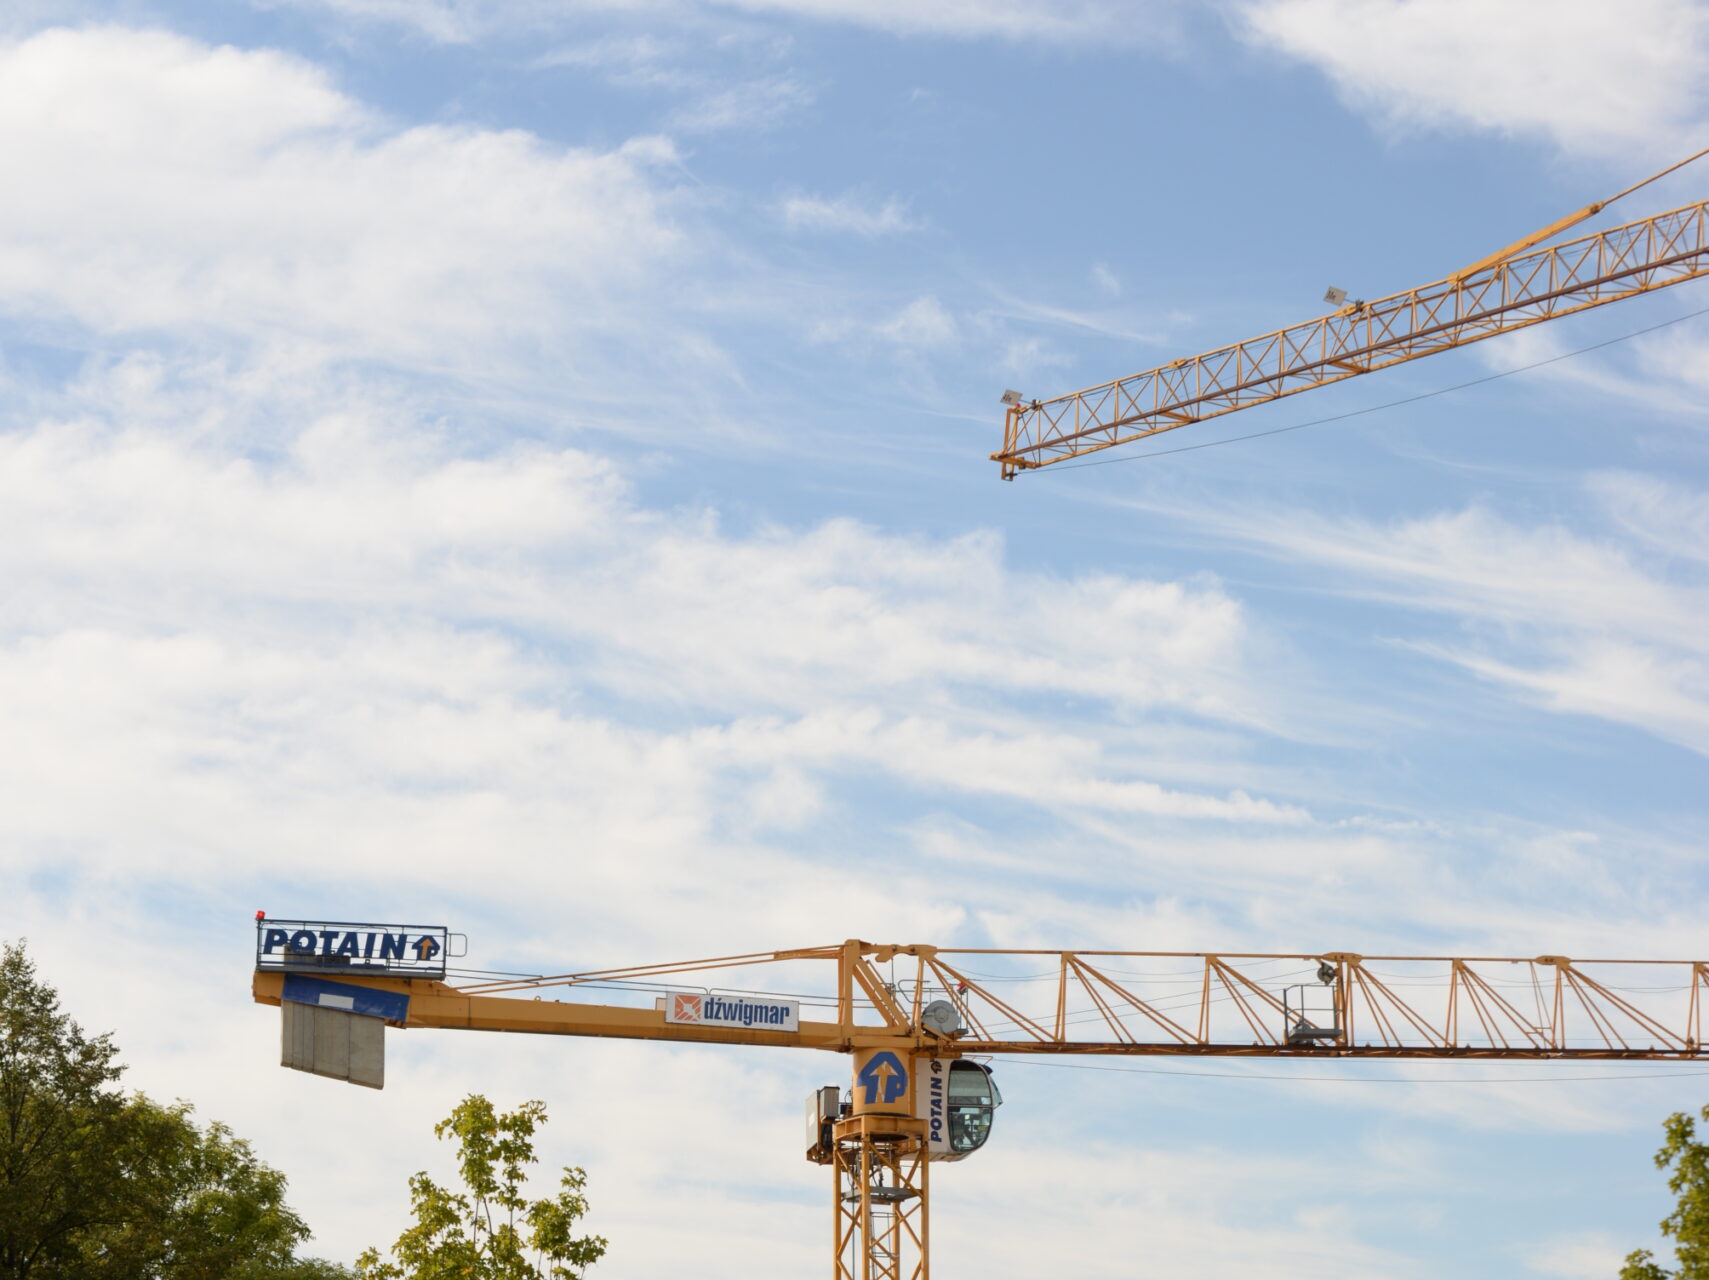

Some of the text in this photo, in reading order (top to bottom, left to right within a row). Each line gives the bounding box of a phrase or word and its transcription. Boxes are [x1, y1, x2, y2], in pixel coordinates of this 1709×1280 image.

[263, 929, 407, 960] POTAIN
[704, 997, 790, 1026] dźwigmar
[930, 1077, 942, 1142] POTAIN
